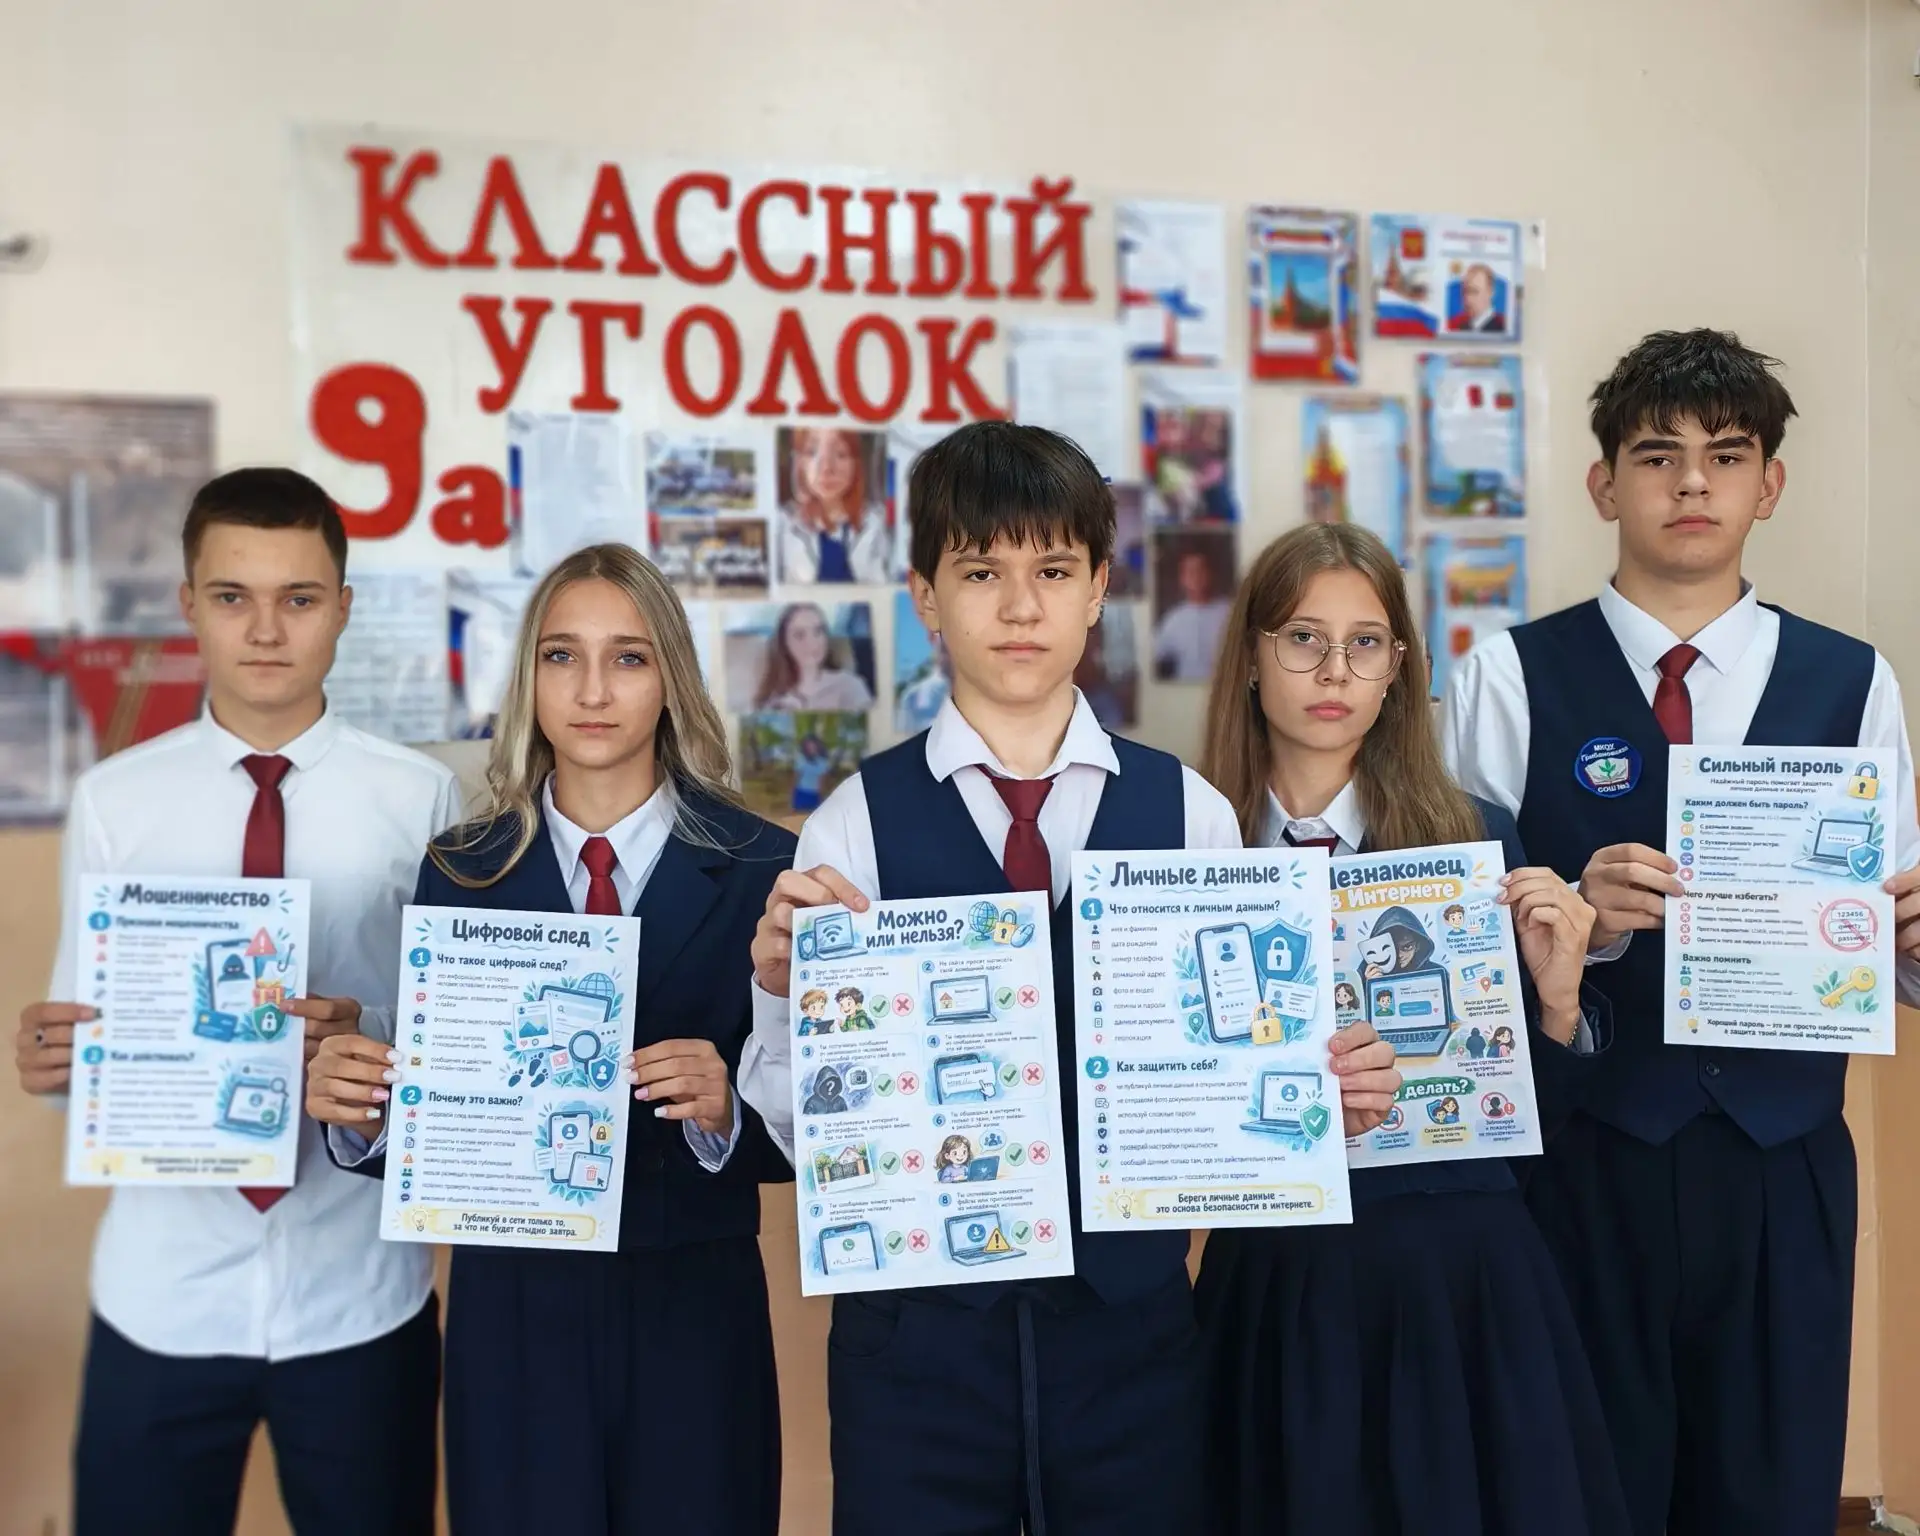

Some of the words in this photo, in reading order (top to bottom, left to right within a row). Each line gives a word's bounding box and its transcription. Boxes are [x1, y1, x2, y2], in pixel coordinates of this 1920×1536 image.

[347, 148, 1093, 302] КЛАССНЫЙ
[462, 296, 1013, 423] УГОЛОК
[1699, 757, 1775, 774] Сильный
[1781, 761, 1844, 777] пароль
[1685, 799, 1713, 807] Каким
[1749, 800, 1771, 808] быть
[1773, 801, 1808, 810] пароль?
[1110, 862, 1198, 888] Личные
[1203, 866, 1281, 887] данные
[120, 884, 270, 907] Мошенничество
[1348, 883, 1454, 908] Интернете
[1684, 890, 1703, 898] Чего
[1705, 892, 1733, 901] лучше
[1735, 892, 1778, 901] избегать?
[1088, 903, 1096, 916] 1
[1109, 903, 1128, 914] Что
[1131, 905, 1181, 914] относится
[1193, 904, 1233, 913] личным
[1235, 900, 1280, 914] данным?
[877, 910, 947, 930] Можно
[452, 918, 543, 943] Цифровой
[548, 929, 591, 948] след
[866, 932, 895, 948] или
[901, 919, 964, 945] нельзя?
[417, 952, 425, 964] 1
[437, 953, 455, 964] Что
[458, 957, 486, 966] такое
[489, 957, 537, 970] цифровой
[539, 959, 568, 972] след?
[1682, 953, 1711, 962] Важно
[1713, 956, 1752, 964] помнить
[1093, 1060, 1102, 1074] 2
[1117, 1061, 1135, 1072] Как
[1138, 1062, 1188, 1073] защитить
[1190, 1058, 1218, 1071] себя?
[1405, 1079, 1468, 1099] делать?
[407, 1090, 416, 1101] 2
[428, 1091, 466, 1106] Почему
[468, 1096, 486, 1104] это
[488, 1096, 523, 1106] важно?
[936, 1116, 942, 1125] 6
[809, 1126, 815, 1136] 5
[942, 1196, 948, 1204] 8
[1178, 1193, 1207, 1205] Береги
[1209, 1194, 1240, 1202] личные
[1242, 1193, 1275, 1202] данные
[1203, 1202, 1260, 1212] безопасности
[1270, 1201, 1314, 1211] интернете.
[461, 1213, 500, 1225] Публикуй
[479, 1223, 491, 1232] не
[491, 1223, 515, 1234] будет
[516, 1227, 547, 1235] стыдно
